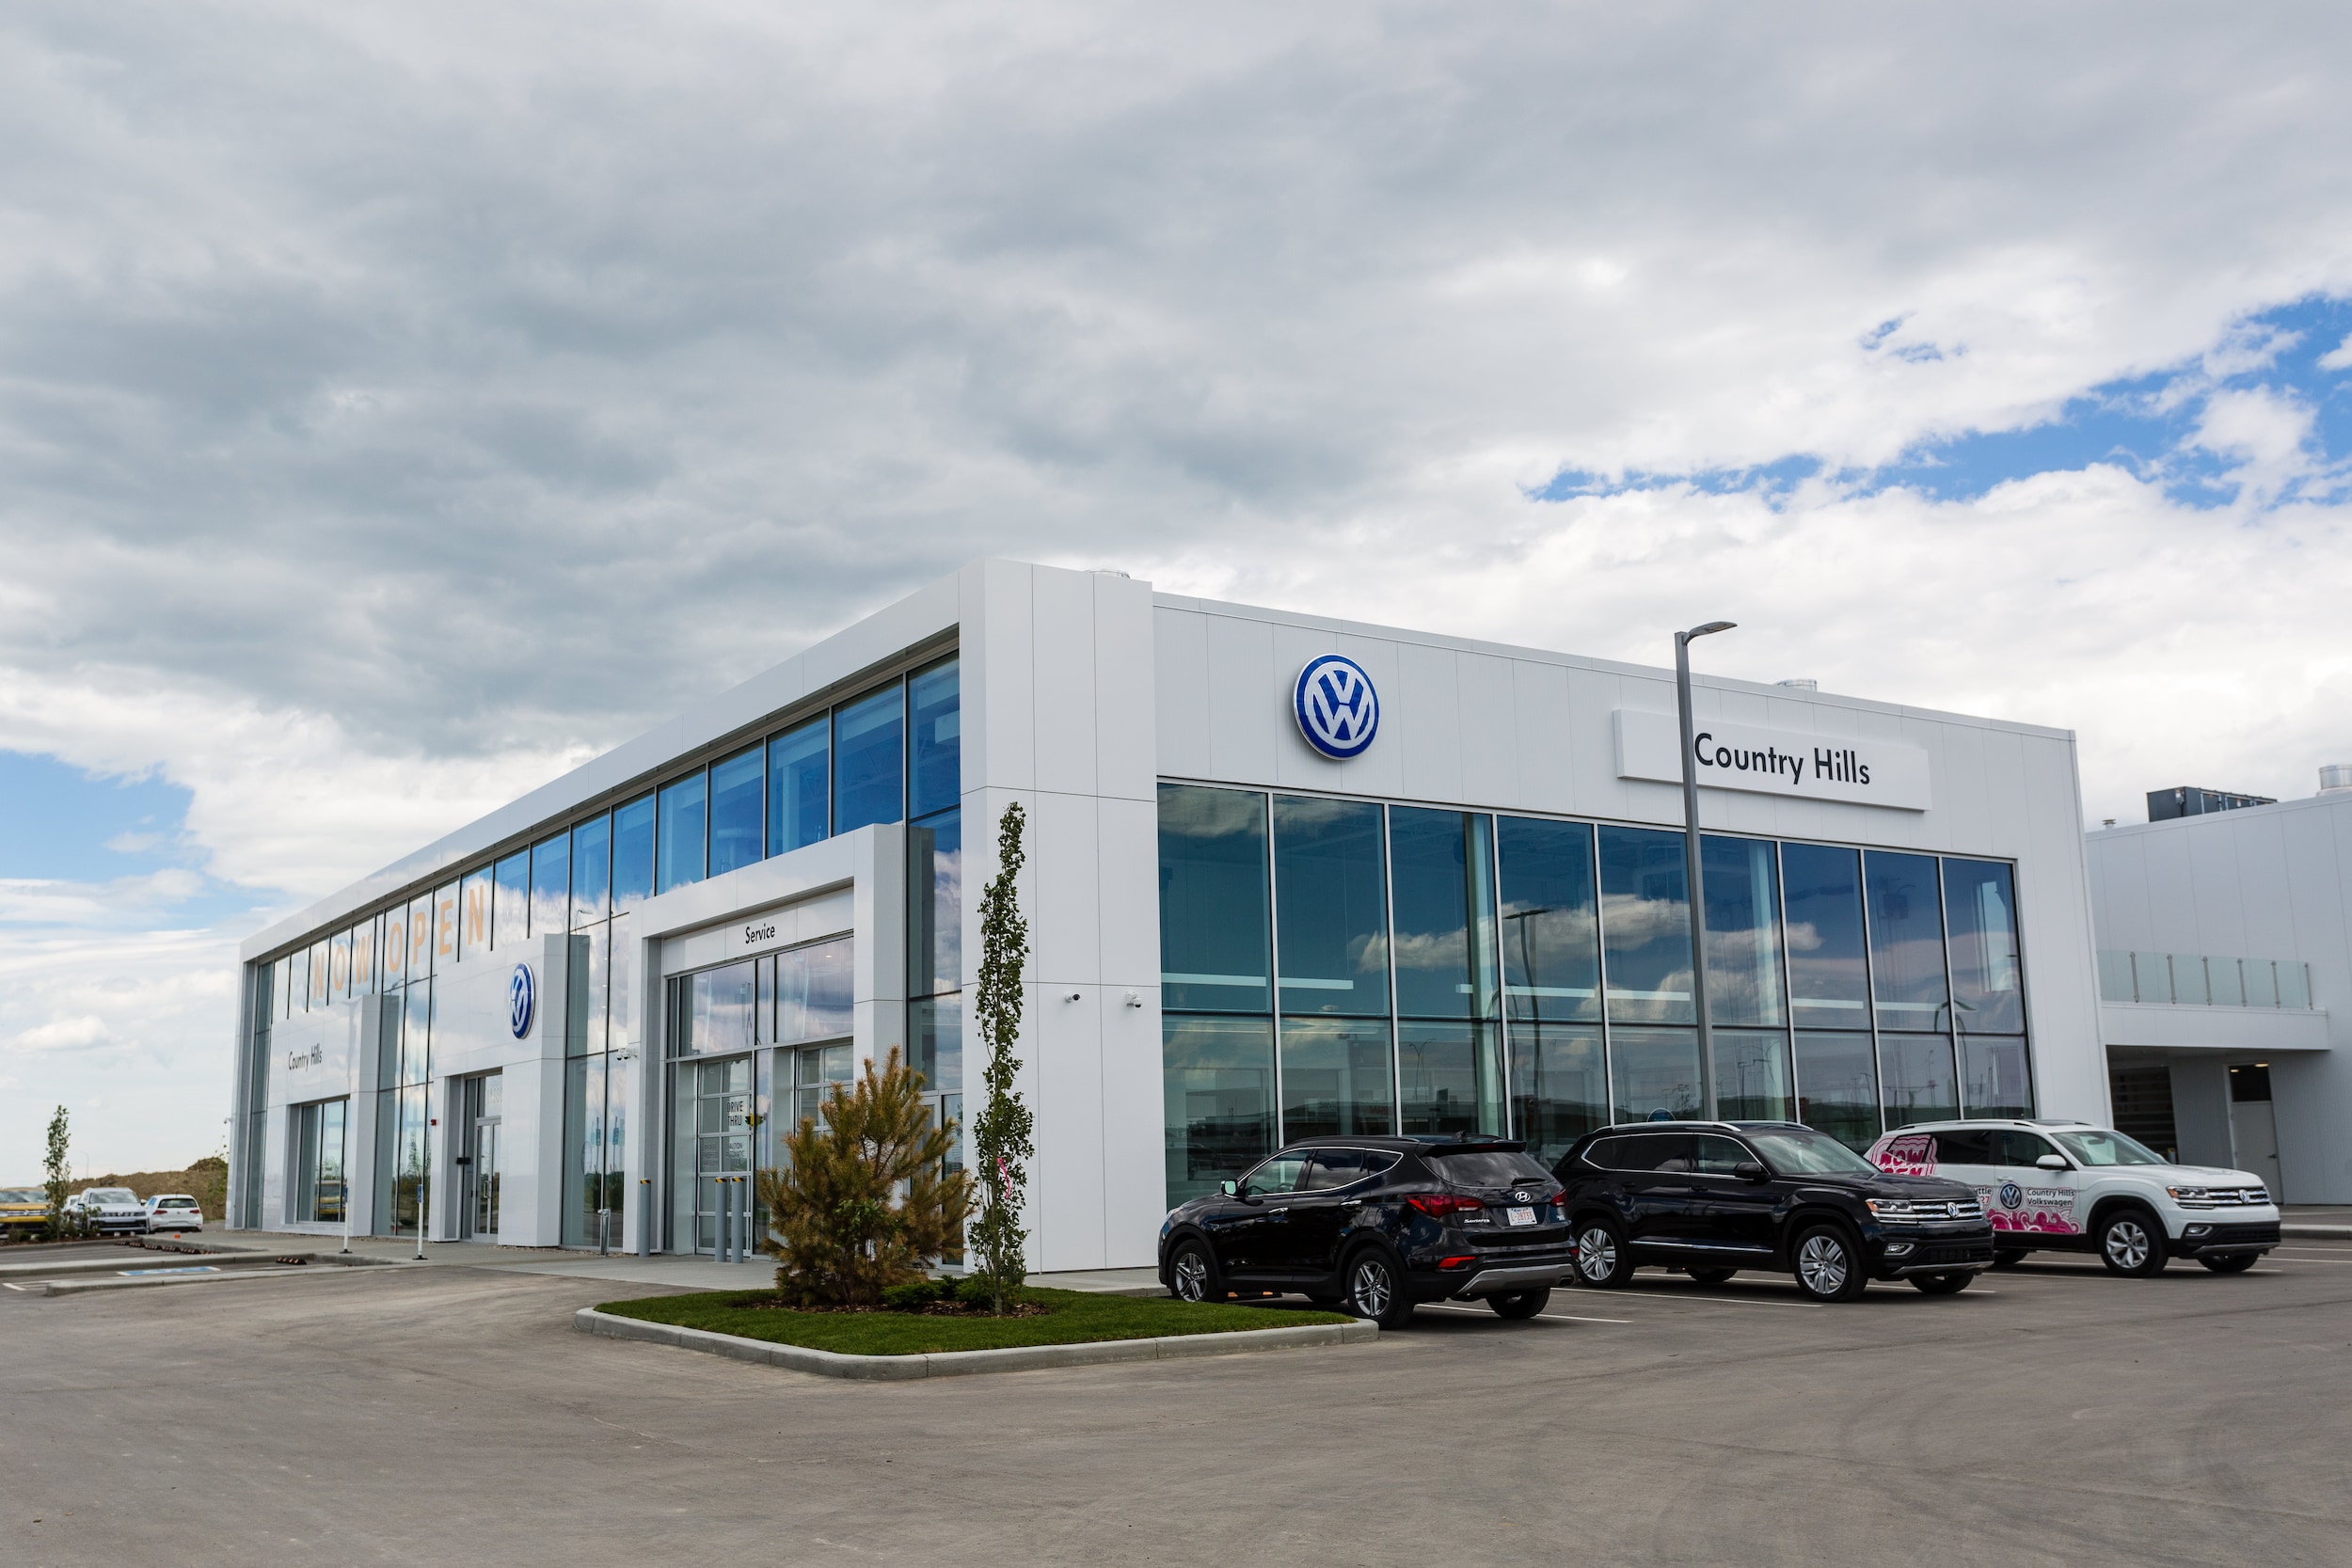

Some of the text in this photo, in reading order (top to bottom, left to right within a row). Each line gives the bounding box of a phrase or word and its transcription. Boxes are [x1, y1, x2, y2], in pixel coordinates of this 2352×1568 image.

[1299, 658, 1376, 752] VW
[1694, 733, 1870, 785] Country Hills
[313, 885, 484, 1000] NOW OPEN
[745, 923, 775, 944] Service
[288, 1043, 322, 1072] Country Hills
[727, 1101, 743, 1113] DRIVE
[727, 1115, 742, 1126] THRU
[1879, 1149, 1925, 1166] NOW
[2026, 1189, 2056, 1197] Country
[2026, 1197, 2073, 1207] Volkswagen
